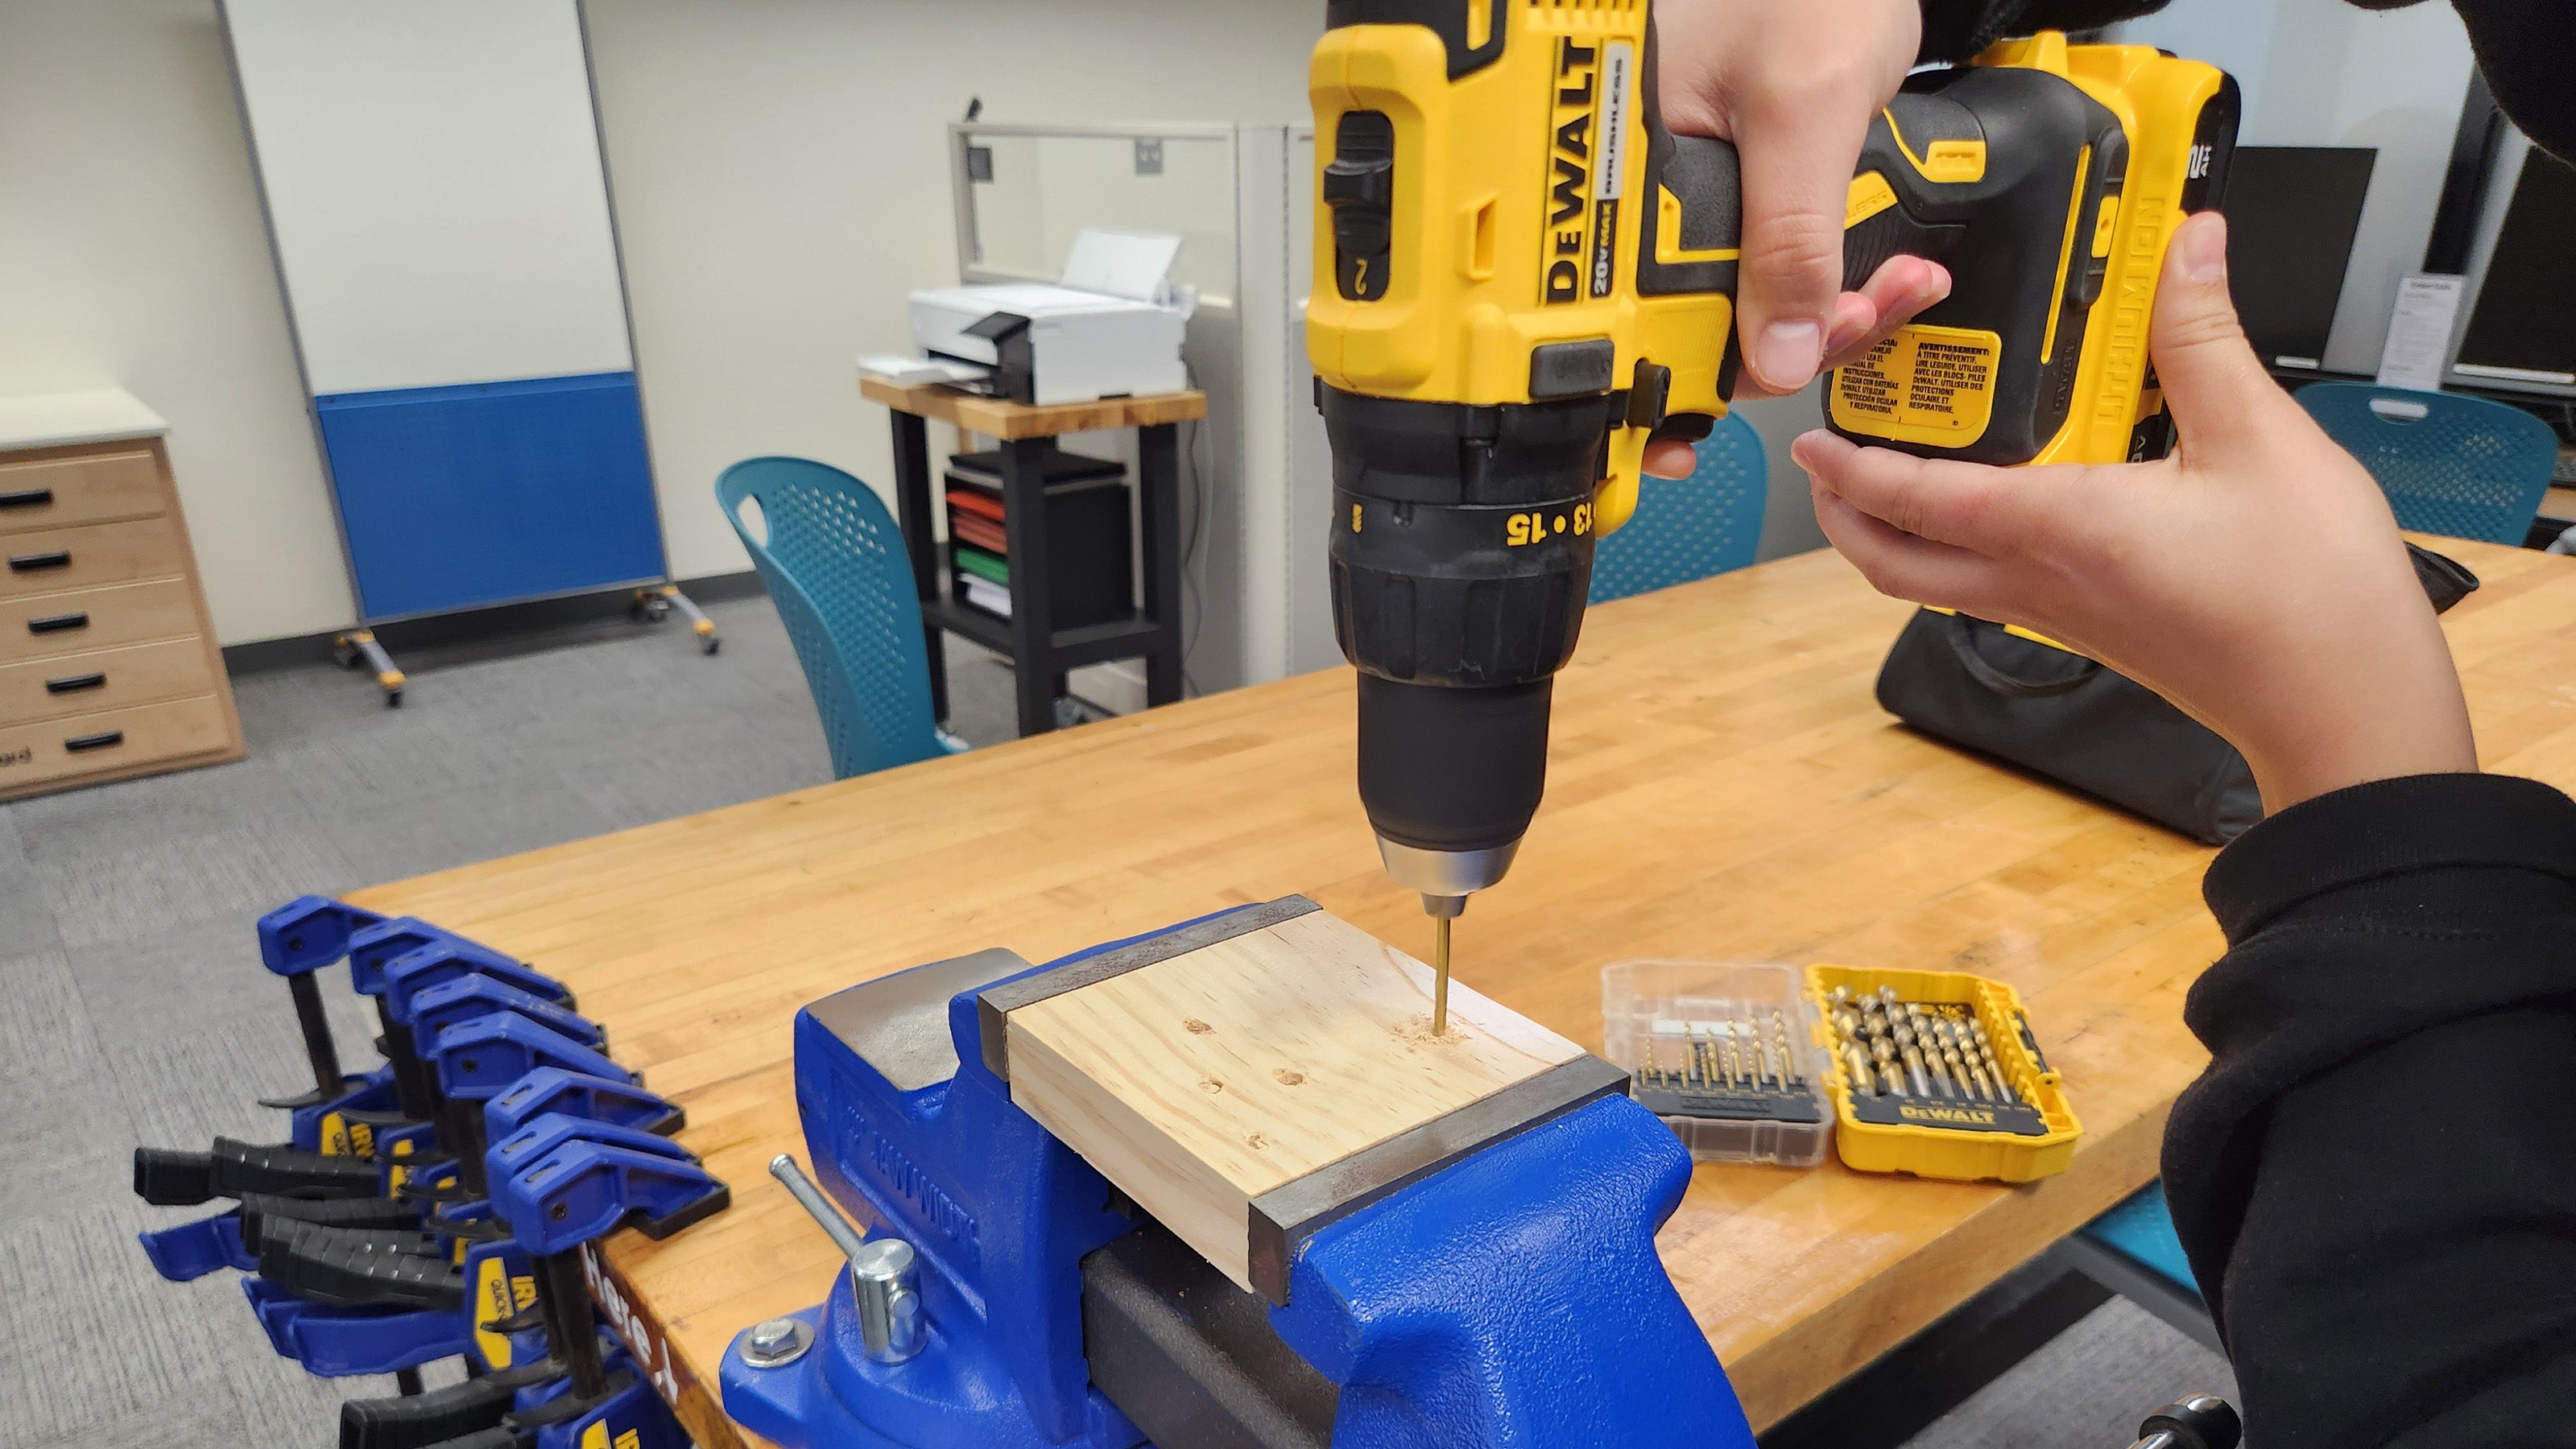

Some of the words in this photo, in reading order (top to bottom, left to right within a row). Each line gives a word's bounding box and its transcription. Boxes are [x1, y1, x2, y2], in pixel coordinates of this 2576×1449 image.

[1605, 57, 1623, 195] BRUSHLESS
[1546, 35, 1594, 303] DEWALT
[1354, 258, 1368, 295] 2
[2094, 275, 2149, 425] LITHIUM
[2129, 197, 2165, 266] ION
[1914, 368, 1931, 377] AVEC
[1967, 374, 1986, 382] PILES
[1958, 364, 1987, 374] UTILISER
[1911, 385, 1954, 396] PROTECTIONS
[1941, 379, 1969, 390] UTILISER
[1970, 382, 1983, 391] DES
[1910, 393, 1941, 403] OCULAIRE
[1506, 512, 1548, 547] 15
[1900, 1105, 1995, 1124] DEWALT
